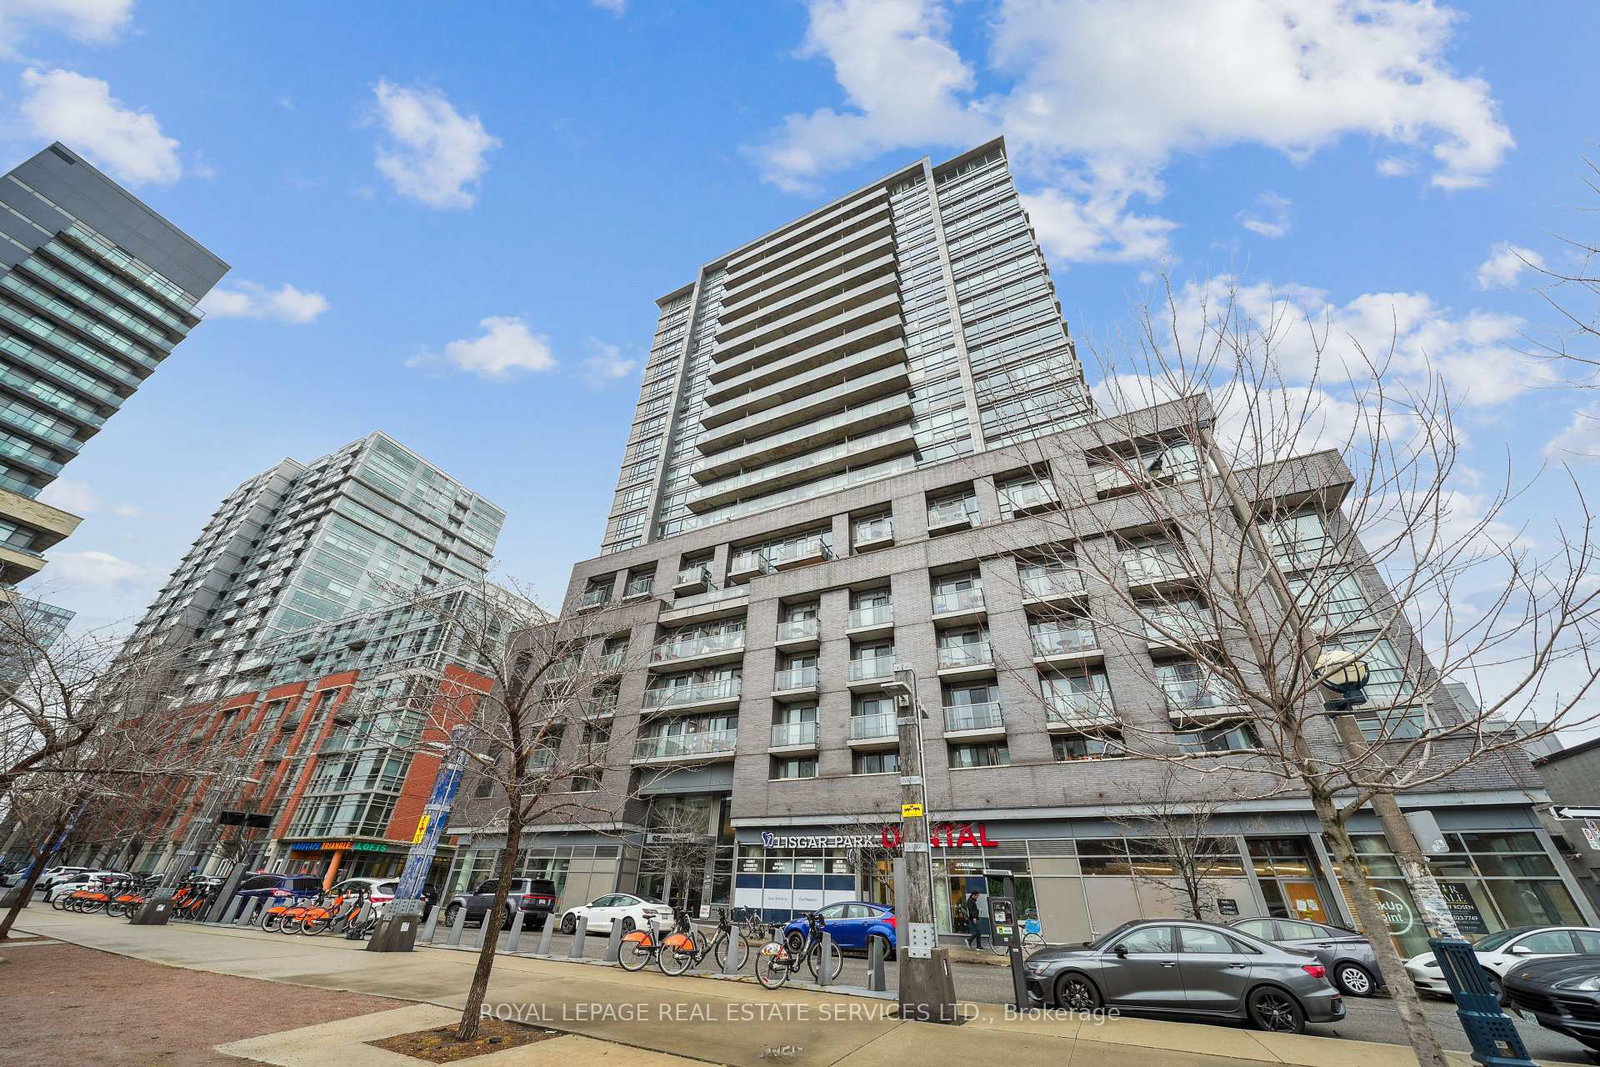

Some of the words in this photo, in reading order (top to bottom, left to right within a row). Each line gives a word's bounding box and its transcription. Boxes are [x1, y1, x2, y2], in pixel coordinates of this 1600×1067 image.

[776, 836, 828, 849] LISGAR
[834, 835, 874, 848] PARK
[881, 821, 999, 848] DTAL
[321, 841, 351, 851] TRIANGLE
[356, 841, 387, 853] LOFTS
[1379, 912, 1404, 922] oint
